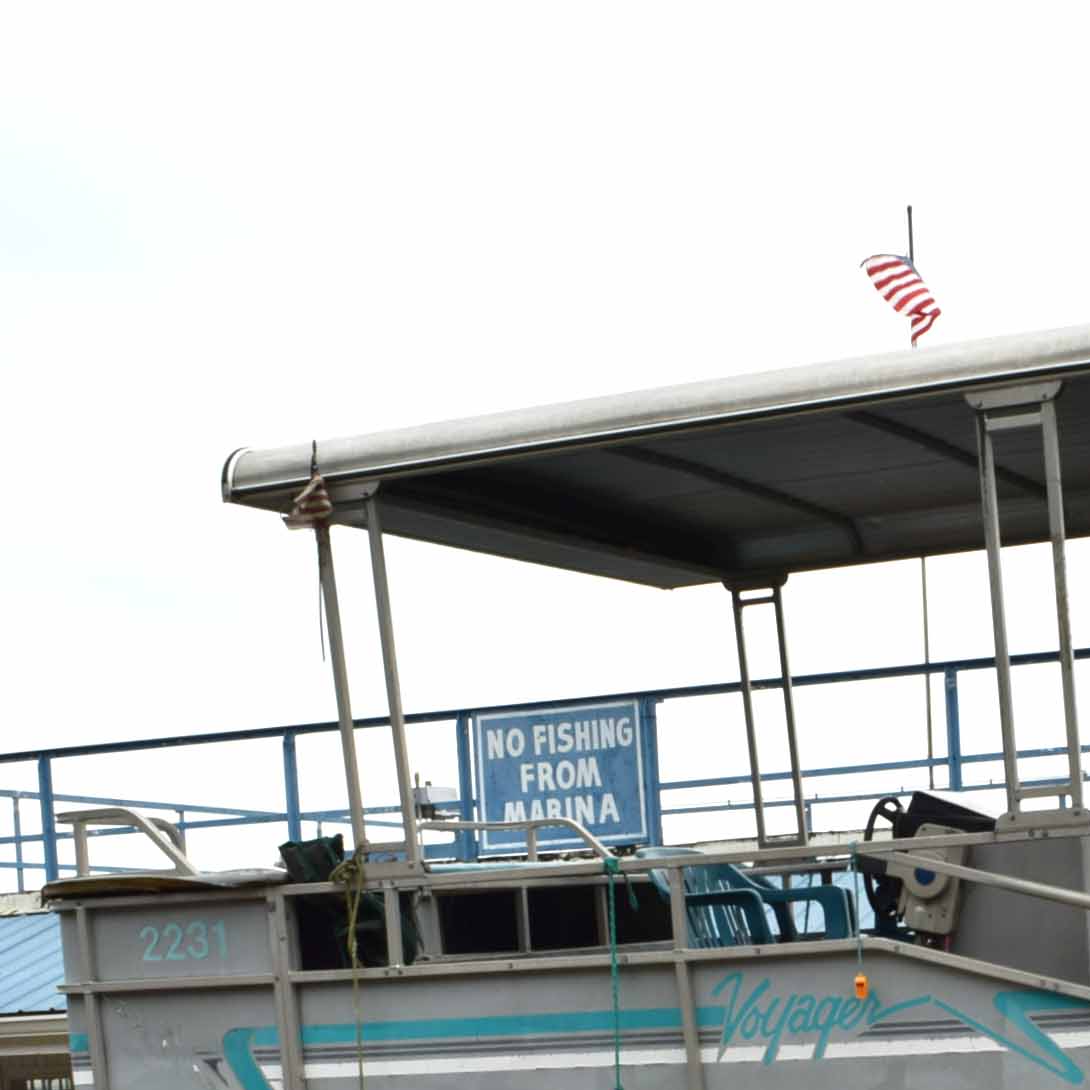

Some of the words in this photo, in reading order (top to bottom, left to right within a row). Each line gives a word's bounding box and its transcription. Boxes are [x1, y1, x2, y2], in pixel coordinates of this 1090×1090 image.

[486, 728, 525, 760] NO
[532, 717, 633, 756] FISHING
[519, 756, 602, 793] FROM
[503, 792, 621, 829] MARINA
[140, 921, 228, 961] 2231
[711, 970, 882, 1067] Voyager
